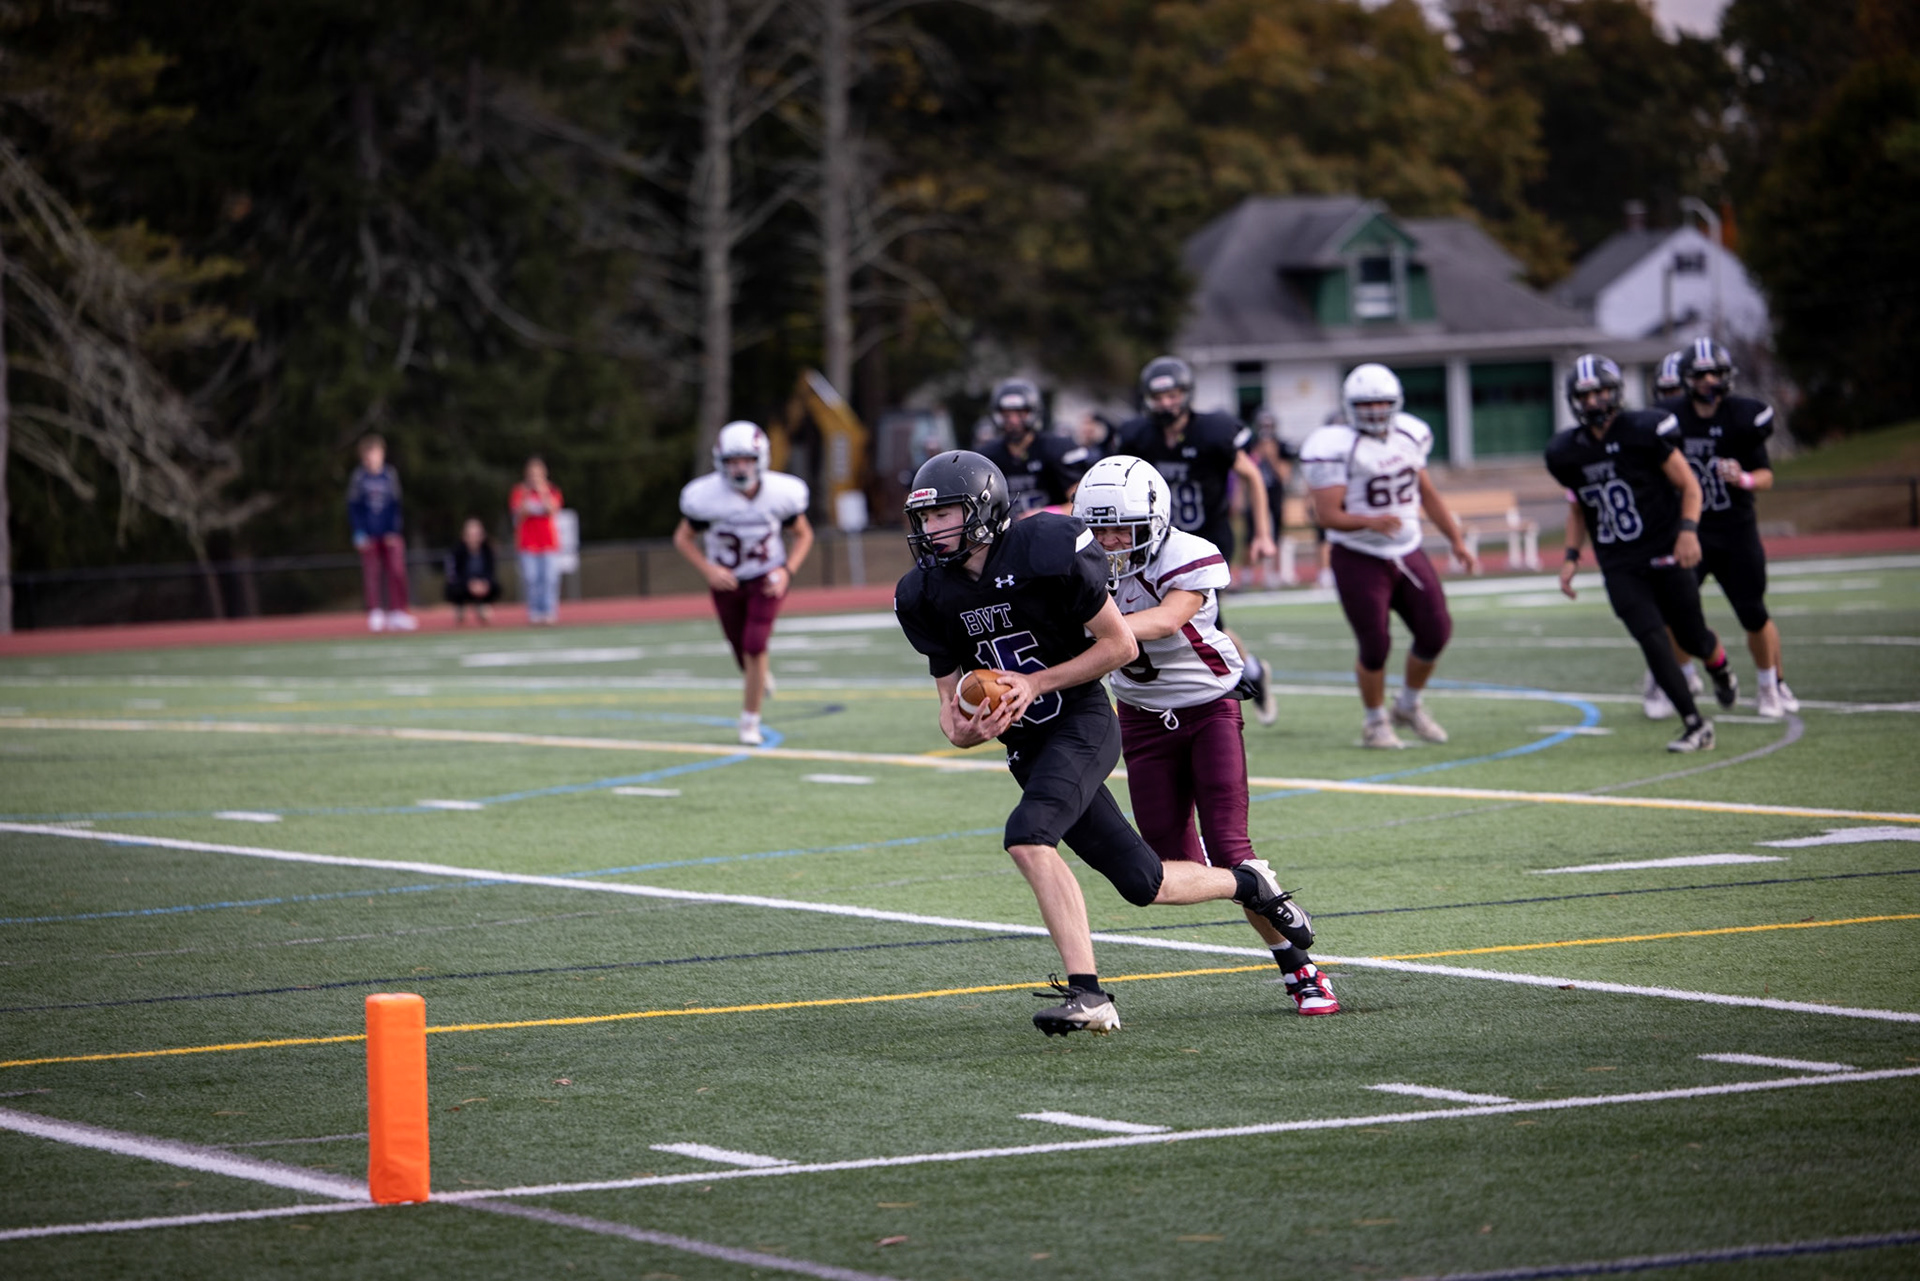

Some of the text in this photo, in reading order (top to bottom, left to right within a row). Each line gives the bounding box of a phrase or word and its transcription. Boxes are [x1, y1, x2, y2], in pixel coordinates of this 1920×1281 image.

[1366, 467, 1416, 507] 62
[1578, 480, 1643, 543] 78
[716, 531, 772, 569] 34
[960, 602, 1013, 636] BVT
[974, 630, 1062, 727] 15
